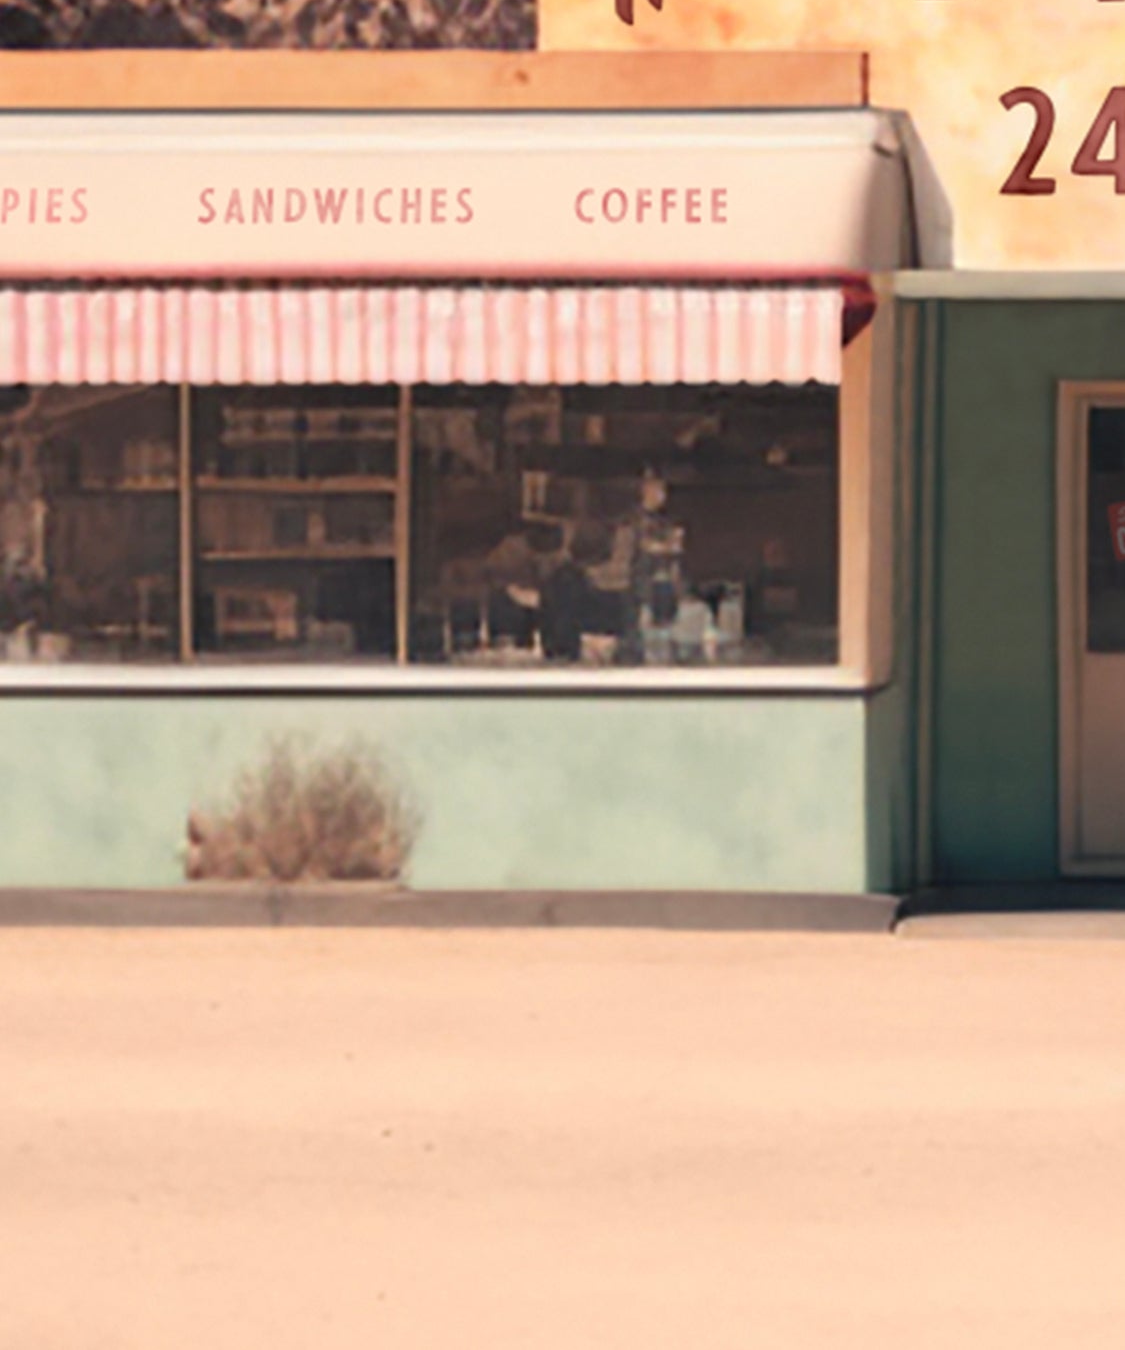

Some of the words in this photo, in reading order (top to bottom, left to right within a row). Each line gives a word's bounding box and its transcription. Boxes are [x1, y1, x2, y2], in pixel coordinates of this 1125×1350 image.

[0, 187, 88, 224] PIES
[197, 187, 475, 225] SANDWICHES
[574, 187, 729, 225] COFFEE
